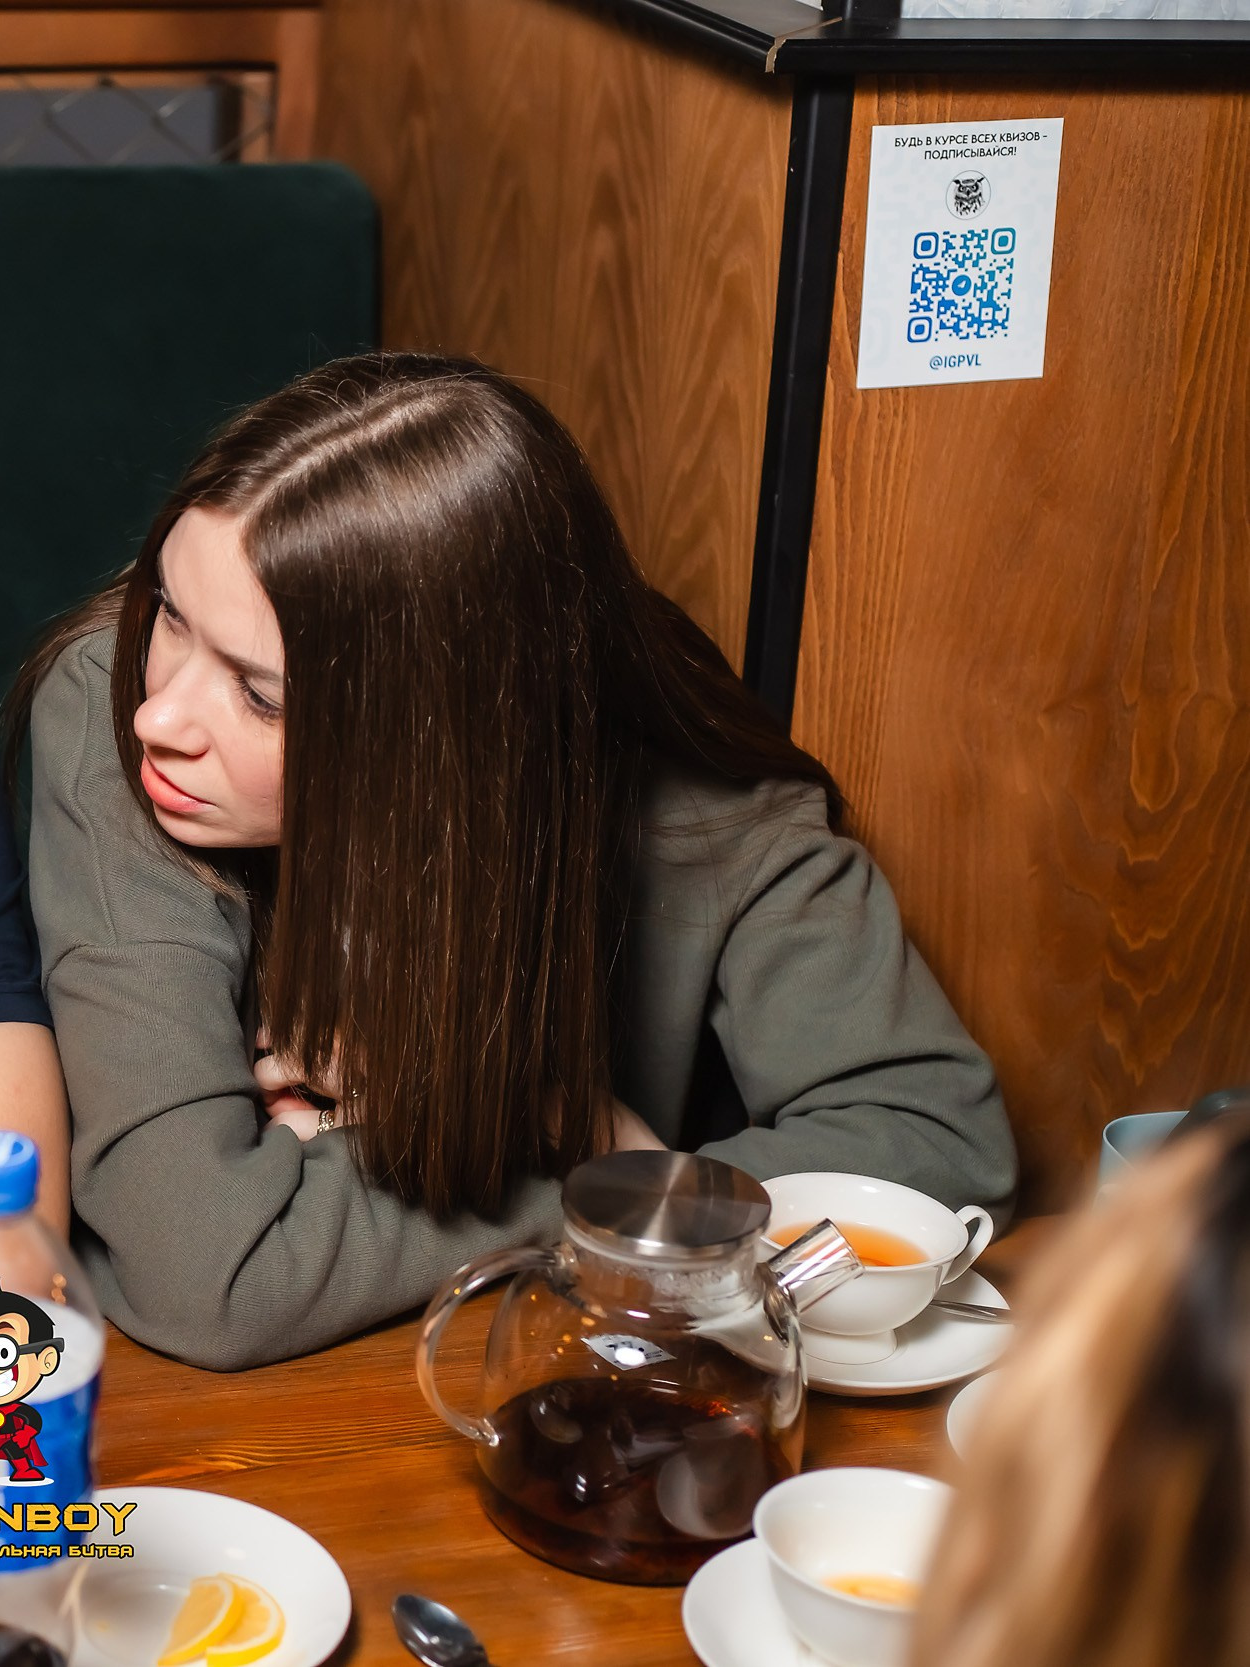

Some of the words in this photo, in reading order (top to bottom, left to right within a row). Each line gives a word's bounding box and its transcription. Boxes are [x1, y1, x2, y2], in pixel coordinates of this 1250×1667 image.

[894, 136, 923, 148] БУДЬ
[925, 136, 933, 146] В
[934, 134, 969, 146] КУРСЕ
[971, 133, 997, 144] ВСЕХ
[999, 131, 1041, 143] КВИЗОВ
[924, 145, 1017, 161] ПОДПИСЫВАЙСЯ!
[929, 354, 982, 370] @IGPVL
